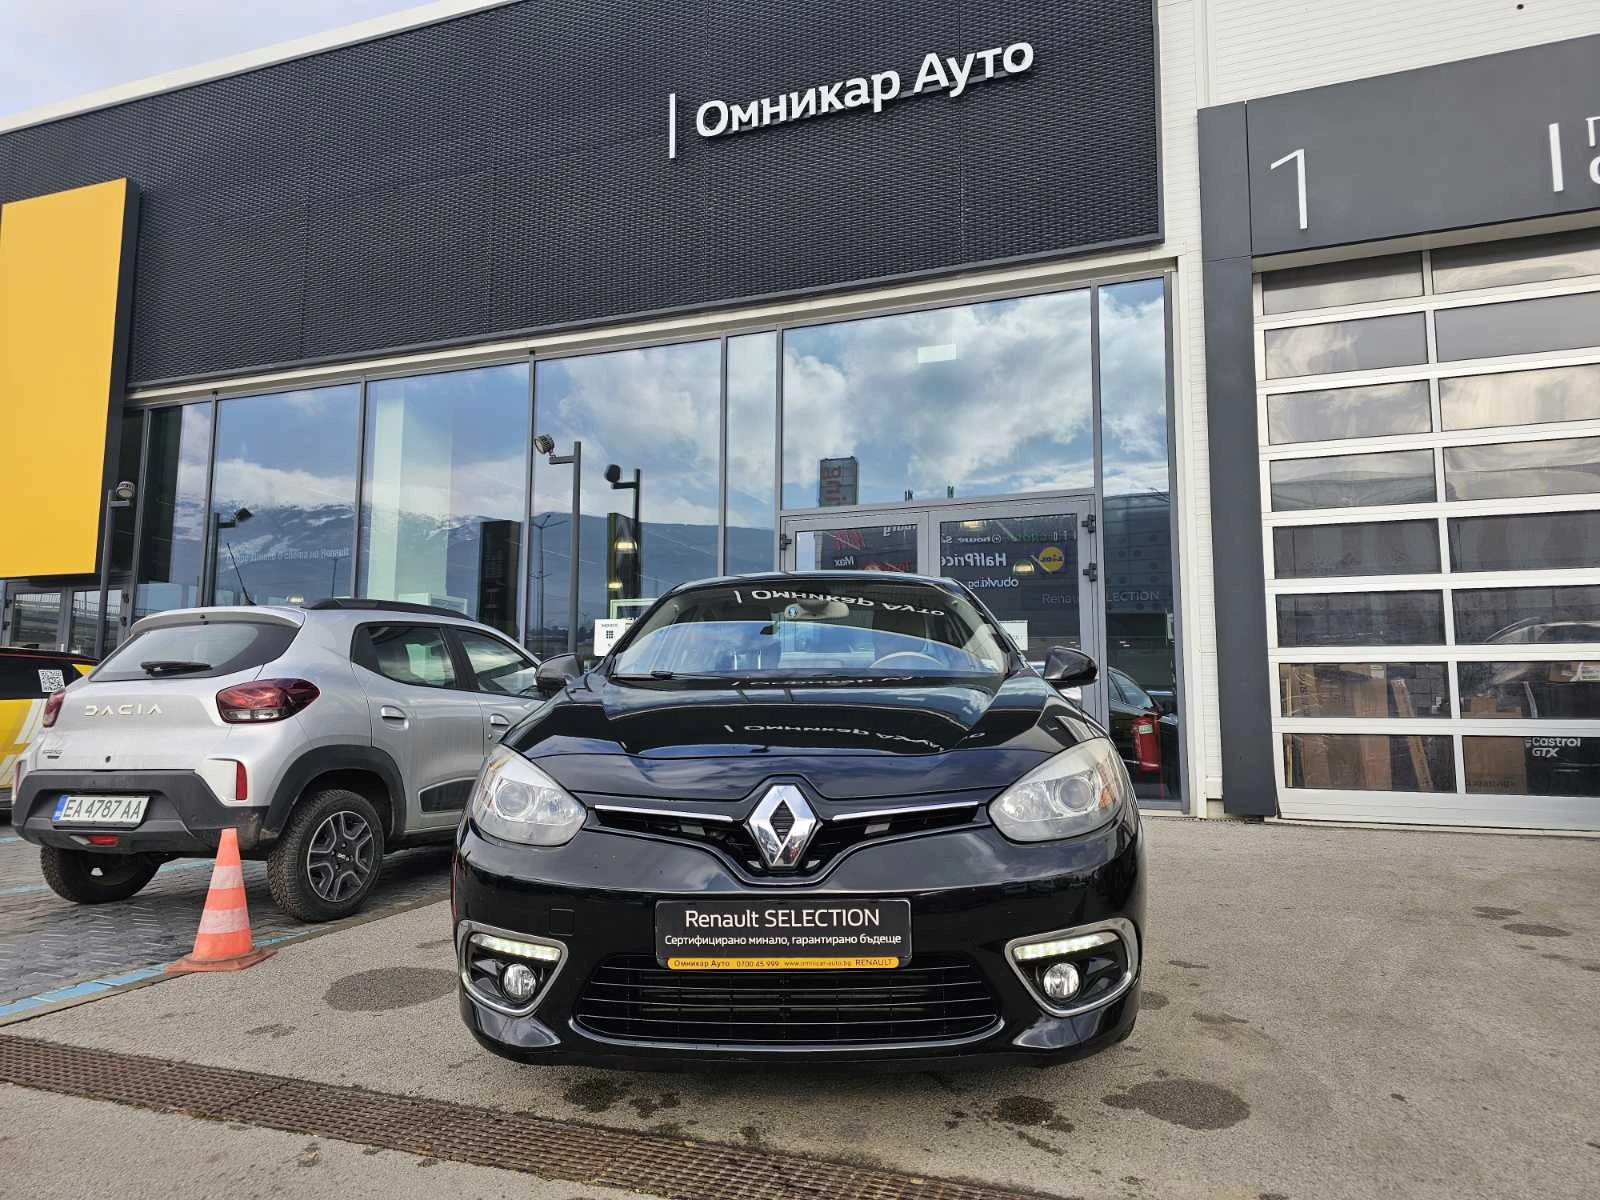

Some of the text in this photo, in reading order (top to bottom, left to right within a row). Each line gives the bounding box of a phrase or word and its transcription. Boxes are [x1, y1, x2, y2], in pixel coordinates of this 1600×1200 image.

[696, 41, 1034, 137] Омникар Ауто
[1270, 148, 1308, 230] 1
[84, 703, 162, 717] DACIA
[1532, 737, 1581, 747] Castrol
[1532, 747, 1560, 758] GTX
[63, 800, 83, 818] EA
[85, 800, 121, 818] 4787
[121, 801, 142, 819] AA
[685, 908, 880, 928] Renault SELECTION
[664, 933, 902, 947] Сертифицирано минало, гарантирано бъдеще
[710, 959, 730, 969] Ауто
[855, 958, 893, 967] RENAULT
